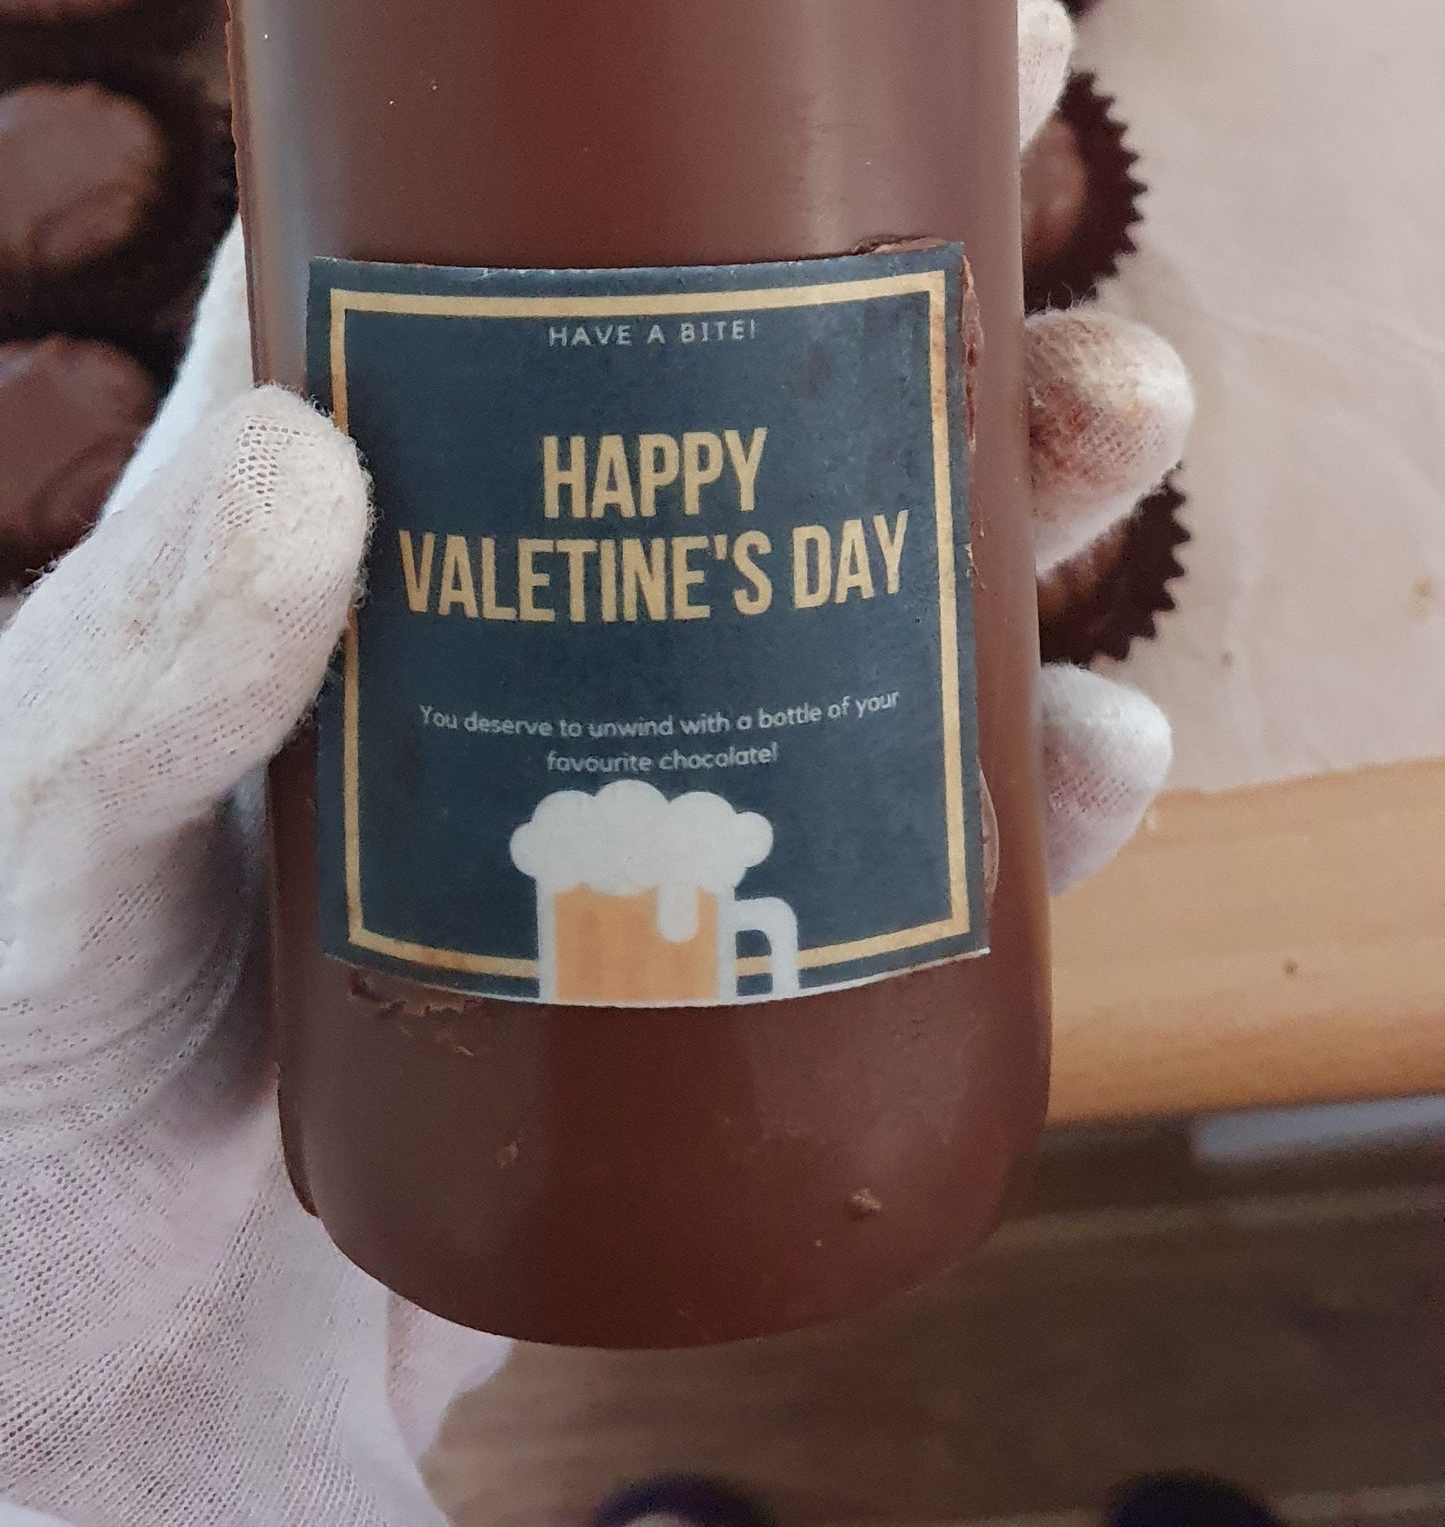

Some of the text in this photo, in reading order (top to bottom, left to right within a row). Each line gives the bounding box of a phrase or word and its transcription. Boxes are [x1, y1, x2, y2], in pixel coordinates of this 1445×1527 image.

[549, 319, 756, 346] HAVE A BITE!
[542, 427, 768, 519] HAPPY
[399, 509, 910, 624] VALETINE'S DAY
[419, 690, 900, 739] You deserve to unwind with a bottle of your
[547, 742, 778, 774] favourite chocolate!
